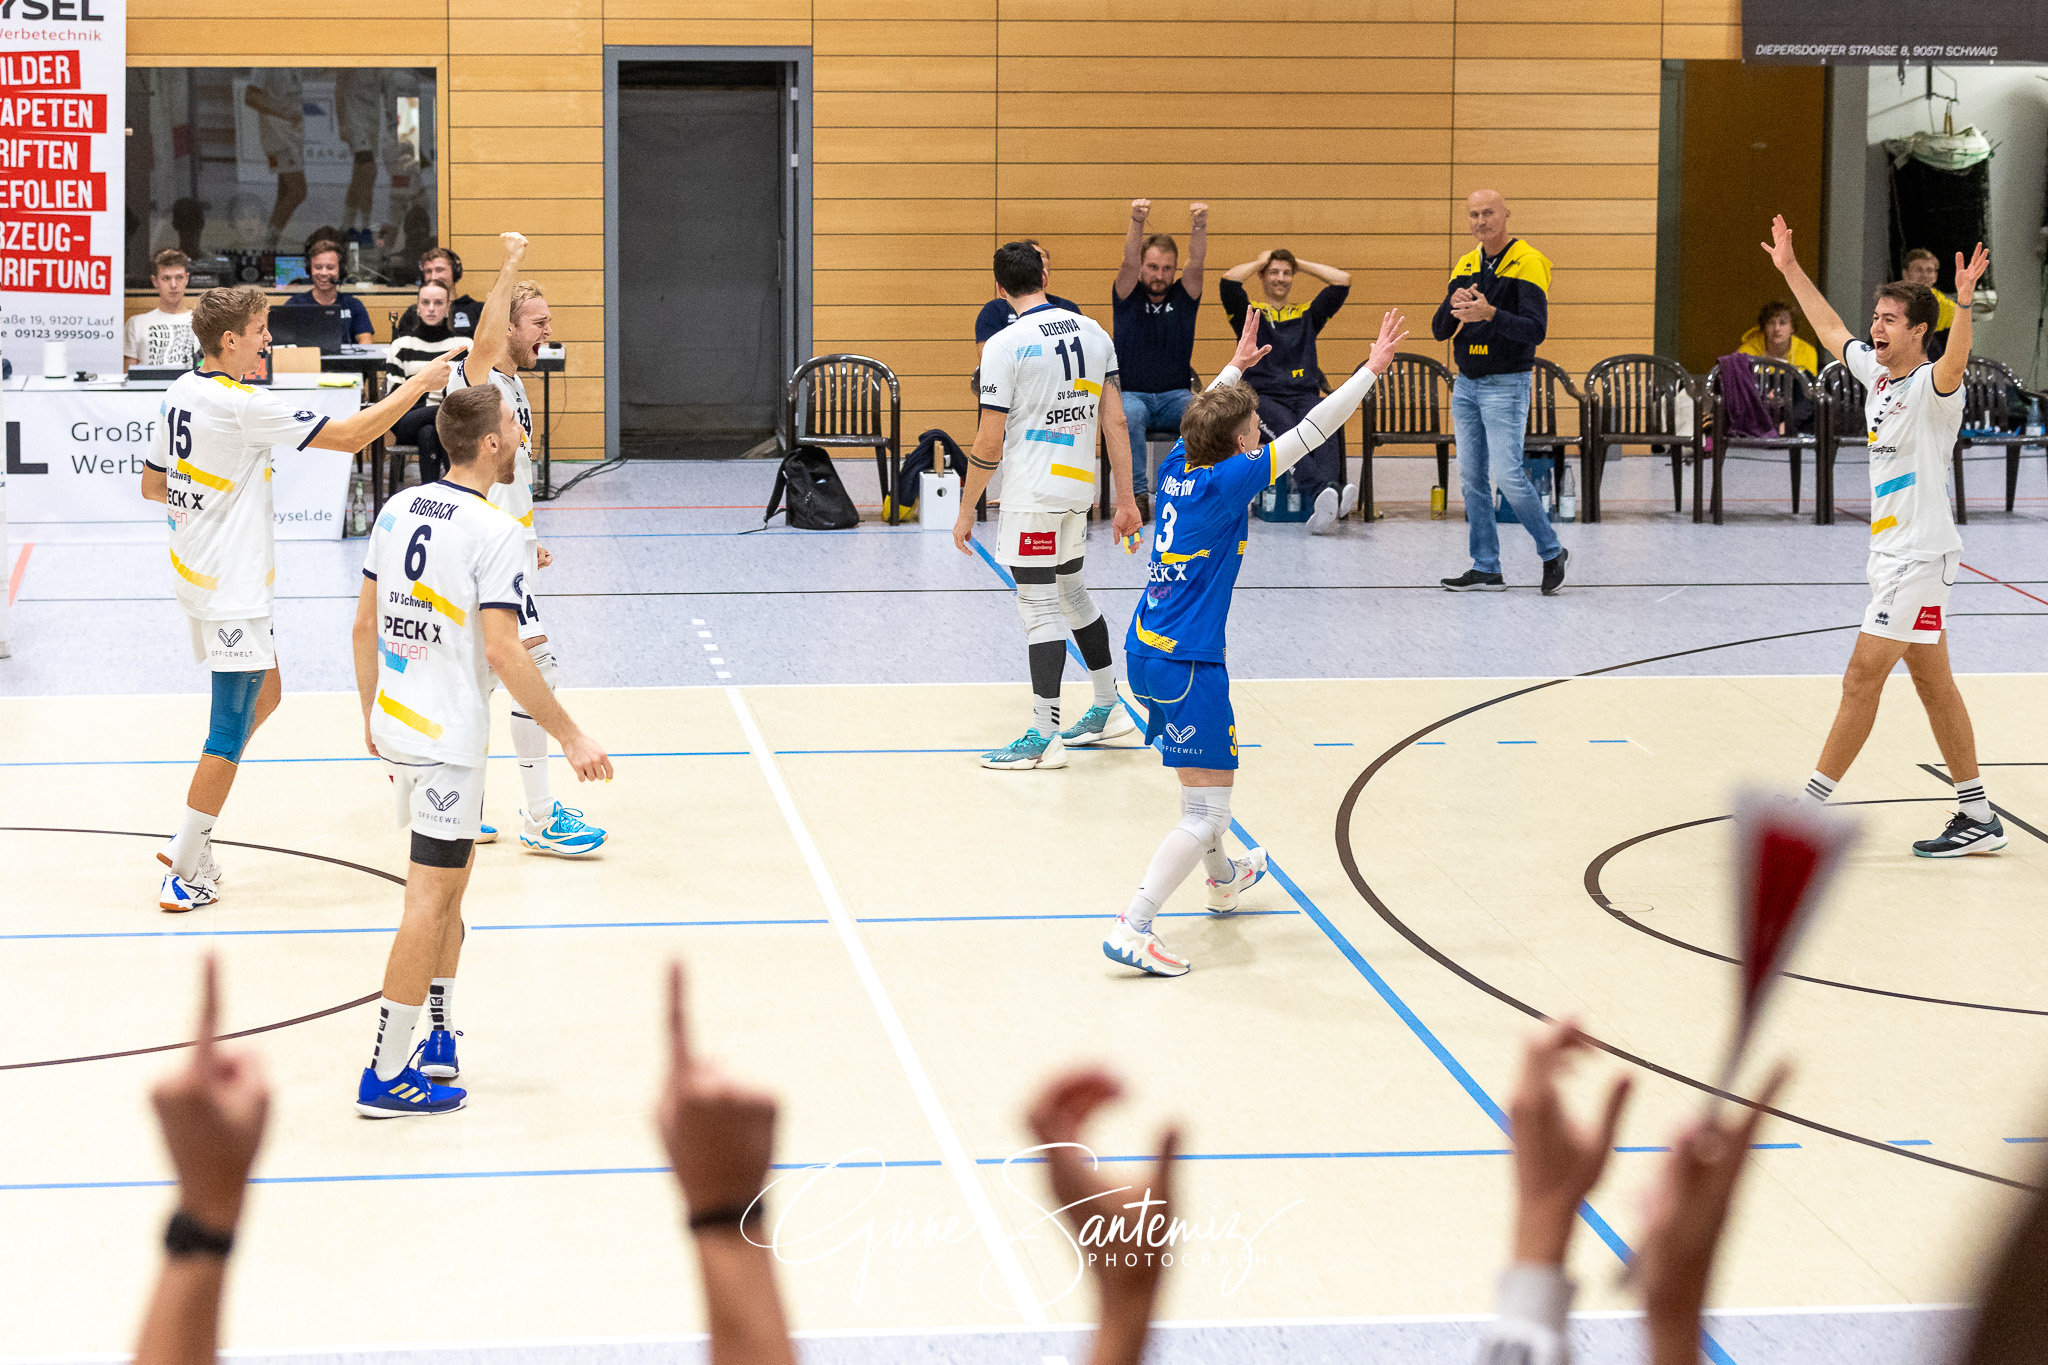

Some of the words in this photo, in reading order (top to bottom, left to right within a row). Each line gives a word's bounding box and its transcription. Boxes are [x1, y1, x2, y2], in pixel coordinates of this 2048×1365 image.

[1755, 44, 1847, 56] DIEPERSDORFER
[1848, 45, 1899, 56] STRASSE
[1901, 45, 1910, 57] 8,
[1913, 45, 1944, 56] 90571
[1945, 45, 1998, 57] SCHWAIG
[0, 97, 93, 128] APETEN
[0, 257, 107, 290] RIFTUNG
[0, 315, 26, 325] aße
[30, 315, 45, 326] 19,
[49, 315, 83, 326] 91207
[87, 316, 115, 326] Lauf
[1038, 318, 1081, 337] DZIERWA
[15, 329, 51, 339] 09123
[54, 330, 114, 340] 999509-0
[1055, 336, 1086, 381] 11
[1469, 344, 1488, 355] MM
[1291, 369, 1304, 378] FT
[1057, 391, 1066, 401] SV
[1045, 405, 1087, 425] SPECK
[71, 421, 156, 442] Großf
[167, 407, 192, 460] 15
[6, 421, 48, 474] L
[409, 497, 459, 521] BIBRACK
[1155, 501, 1178, 553] 3
[404, 524, 432, 582] 6
[389, 591, 400, 603] SV
[400, 593, 433, 612] Schwaig
[1228, 724, 1238, 757] 3
